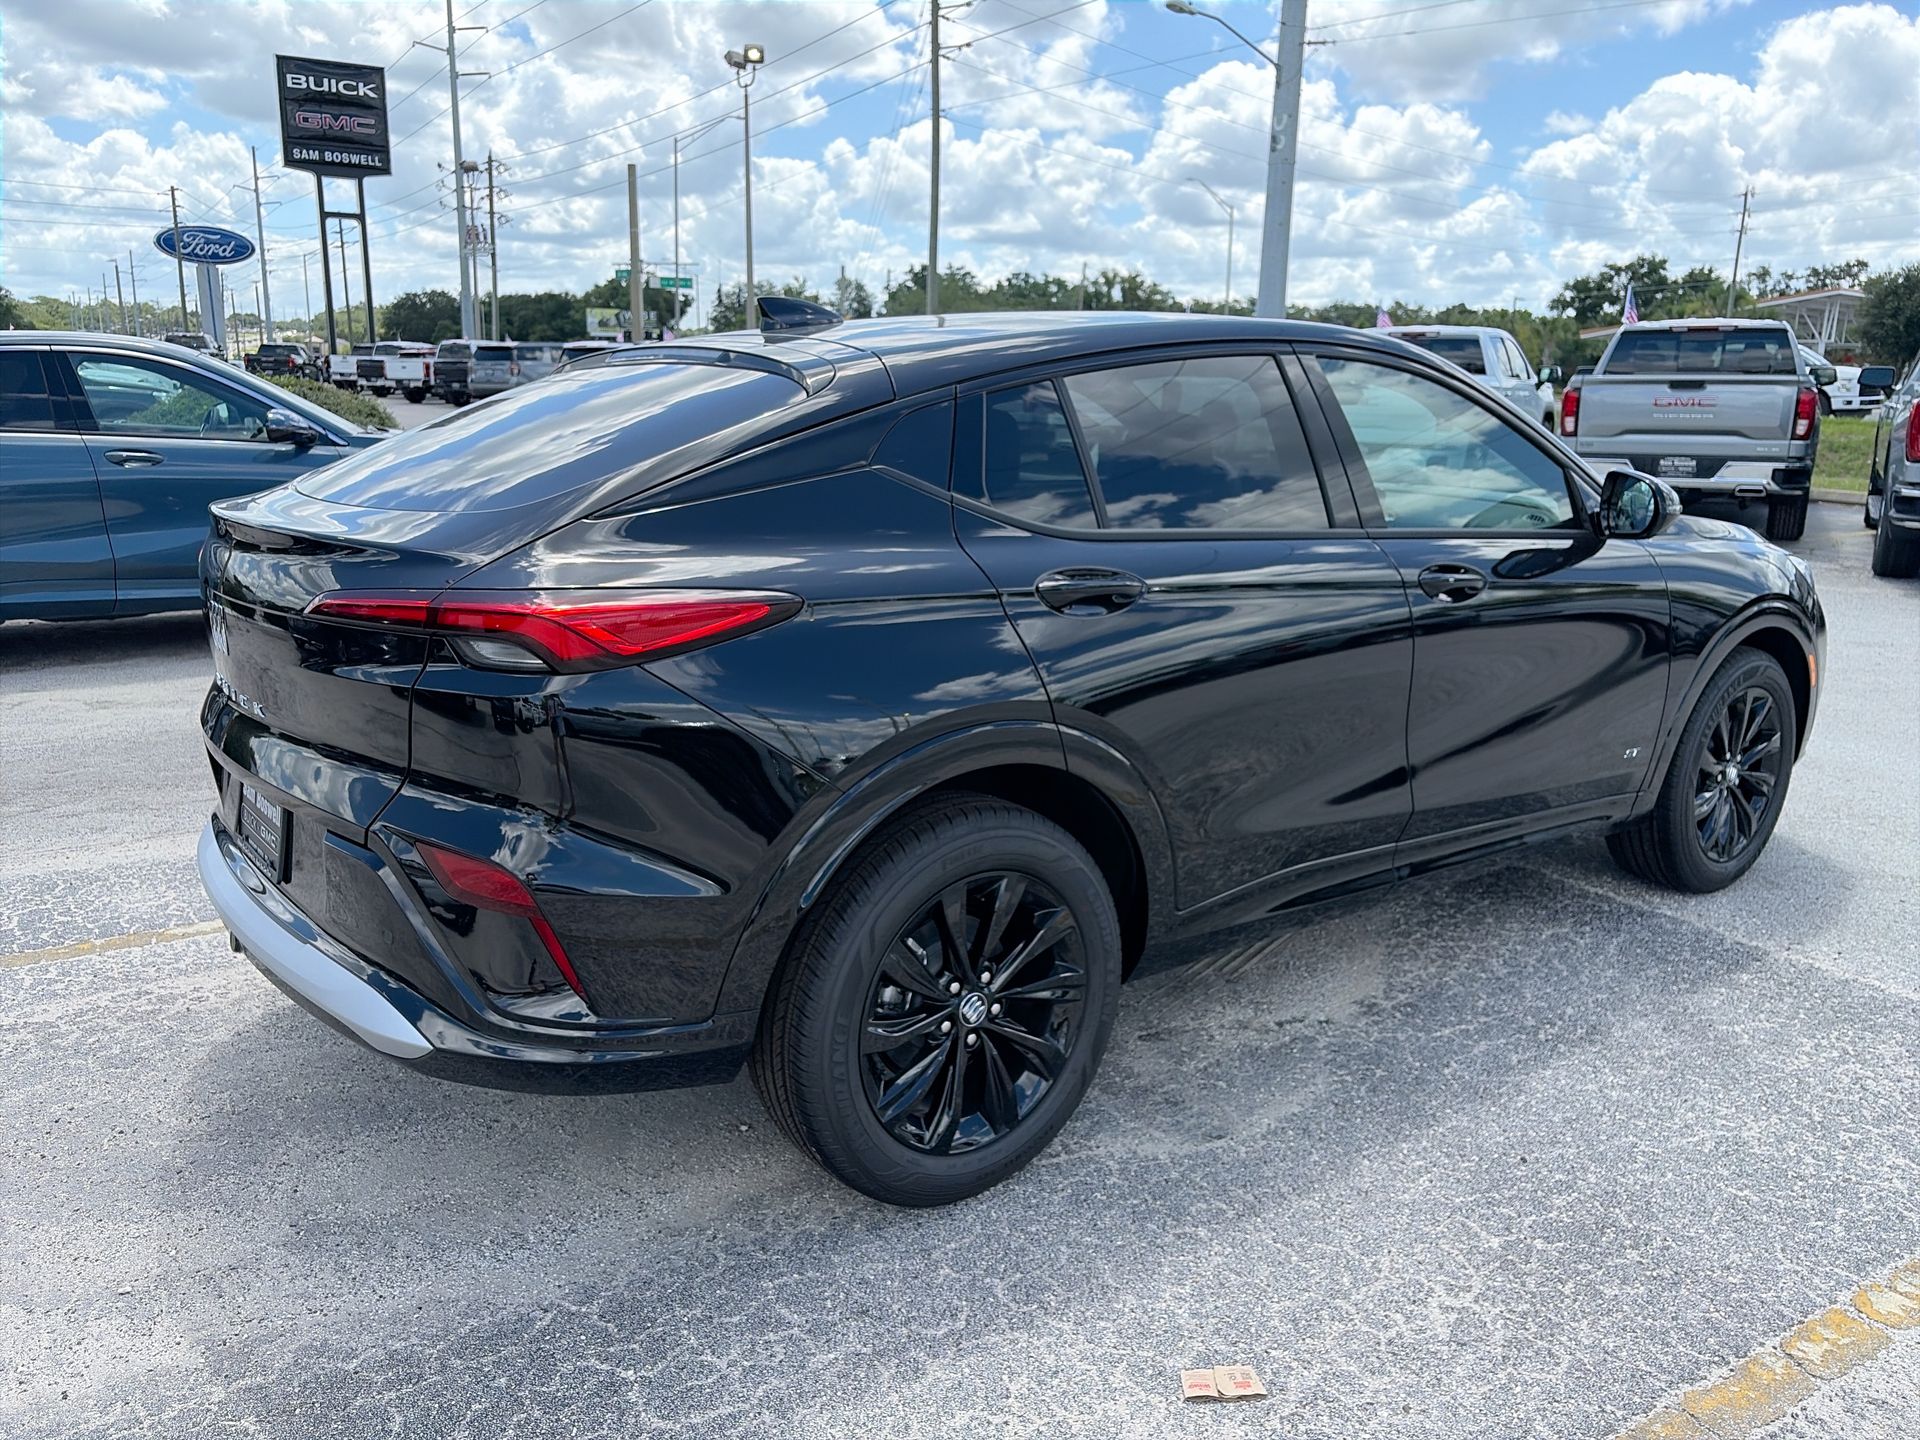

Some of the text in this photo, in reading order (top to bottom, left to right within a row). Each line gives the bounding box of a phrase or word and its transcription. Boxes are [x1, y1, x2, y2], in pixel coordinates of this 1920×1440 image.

[286, 73, 378, 98] BUICK
[295, 111, 376, 134] GMC
[292, 147, 382, 166] SAM BOSWELL
[180, 231, 235, 257] Ford
[1653, 396, 1717, 408] GMC
[260, 825, 277, 849] GMC
